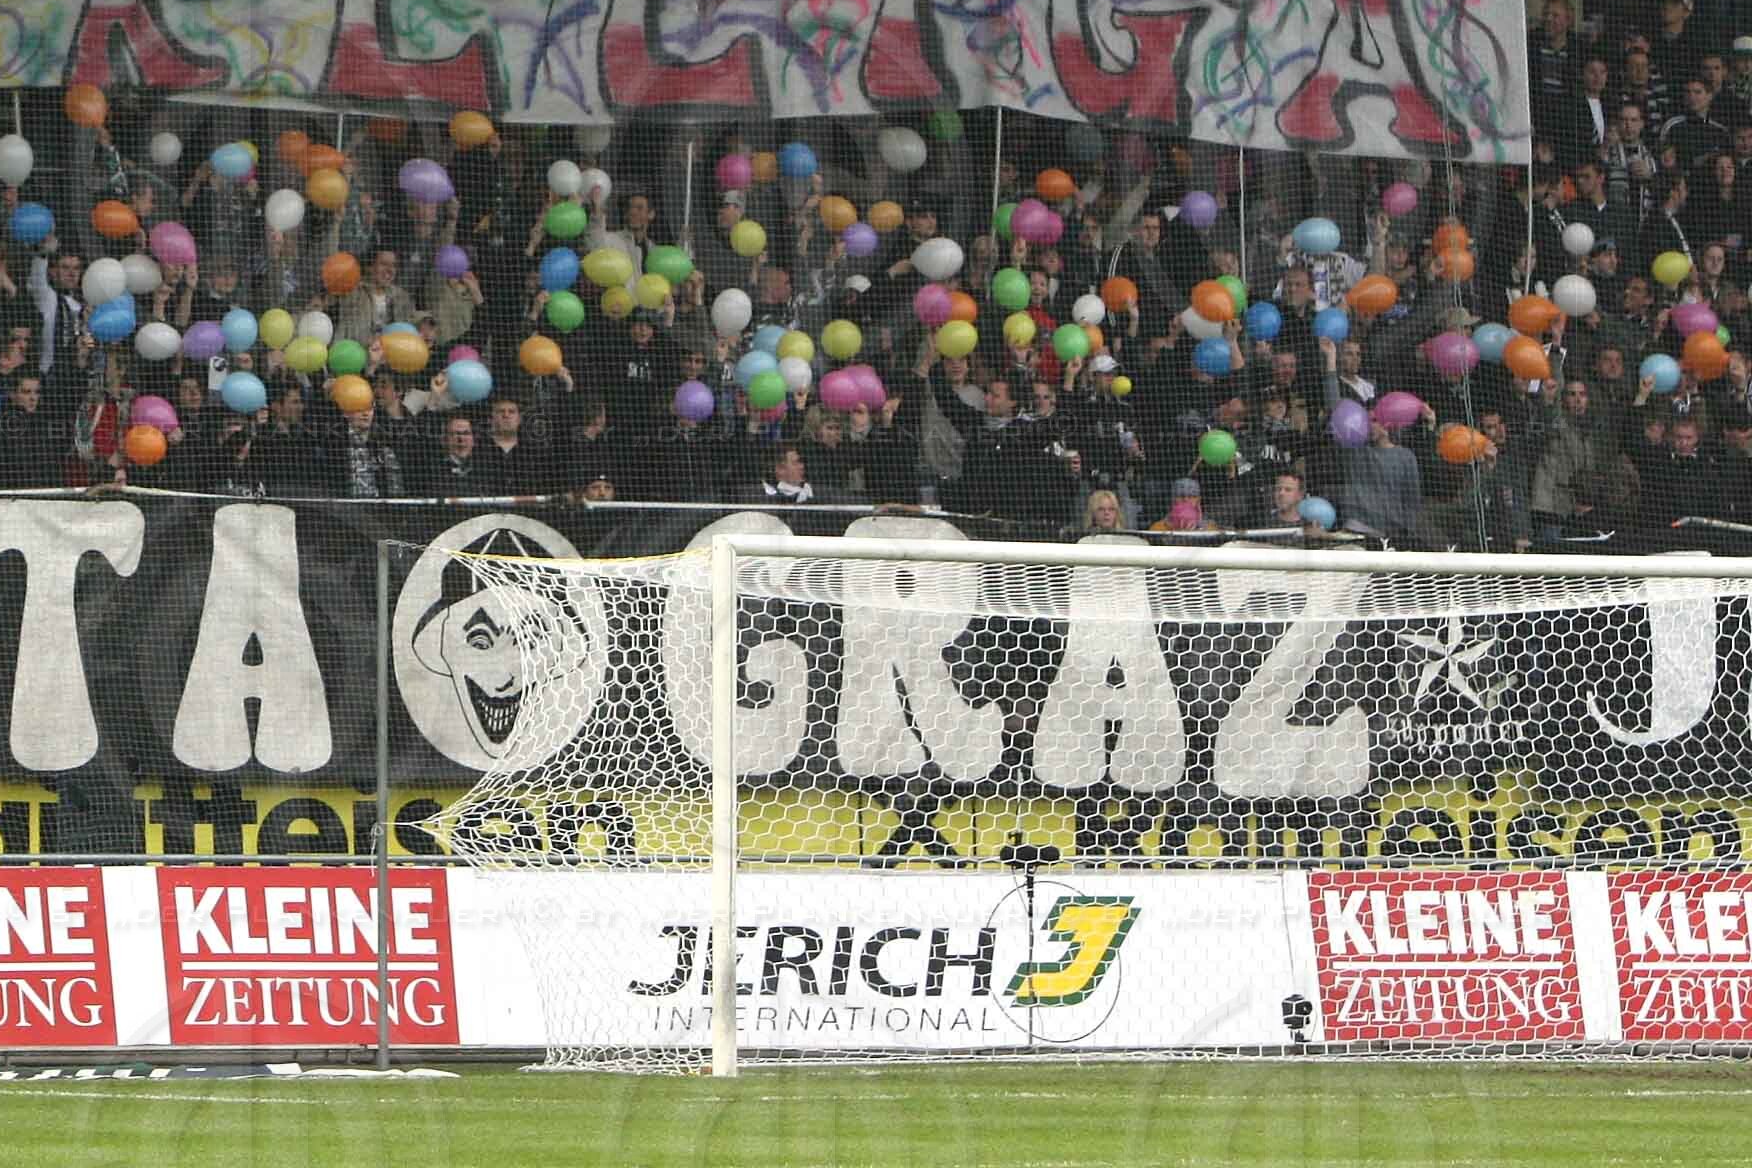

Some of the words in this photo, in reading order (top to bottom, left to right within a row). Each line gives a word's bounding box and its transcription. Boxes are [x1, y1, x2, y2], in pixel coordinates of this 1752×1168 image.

[661, 512, 1371, 798] GRAZ
[174, 885, 439, 955] KLEINE
[1324, 890, 1562, 955] KLEINE
[1624, 890, 1752, 955] KLE
[627, 926, 997, 996] JERICH
[179, 976, 446, 1028] ZEITUNG
[654, 1006, 998, 1032] INTERNATIONAL
[1333, 975, 1572, 1023] ZEITUNG
